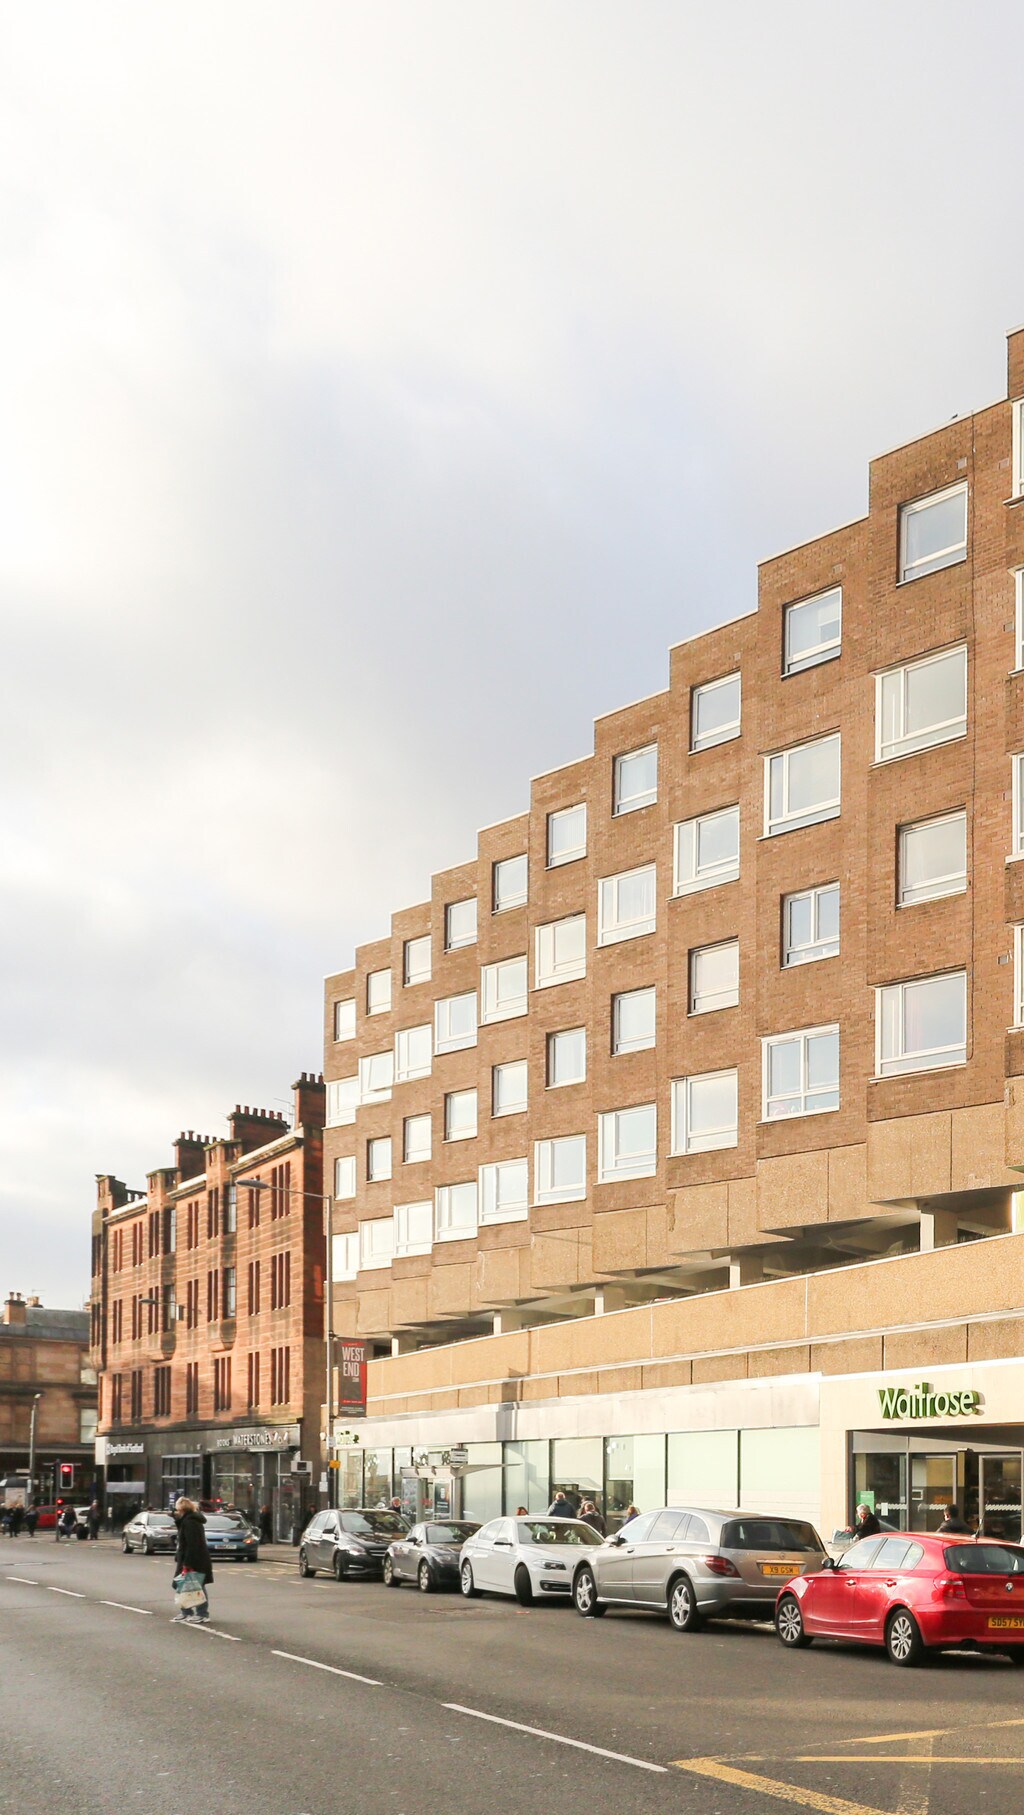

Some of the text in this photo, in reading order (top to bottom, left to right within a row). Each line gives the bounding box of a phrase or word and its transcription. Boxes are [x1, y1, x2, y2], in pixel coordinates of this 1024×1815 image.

[342, 1347, 365, 1361] WEST
[343, 1362, 360, 1376] END
[877, 1382, 981, 1419] Waitrose
